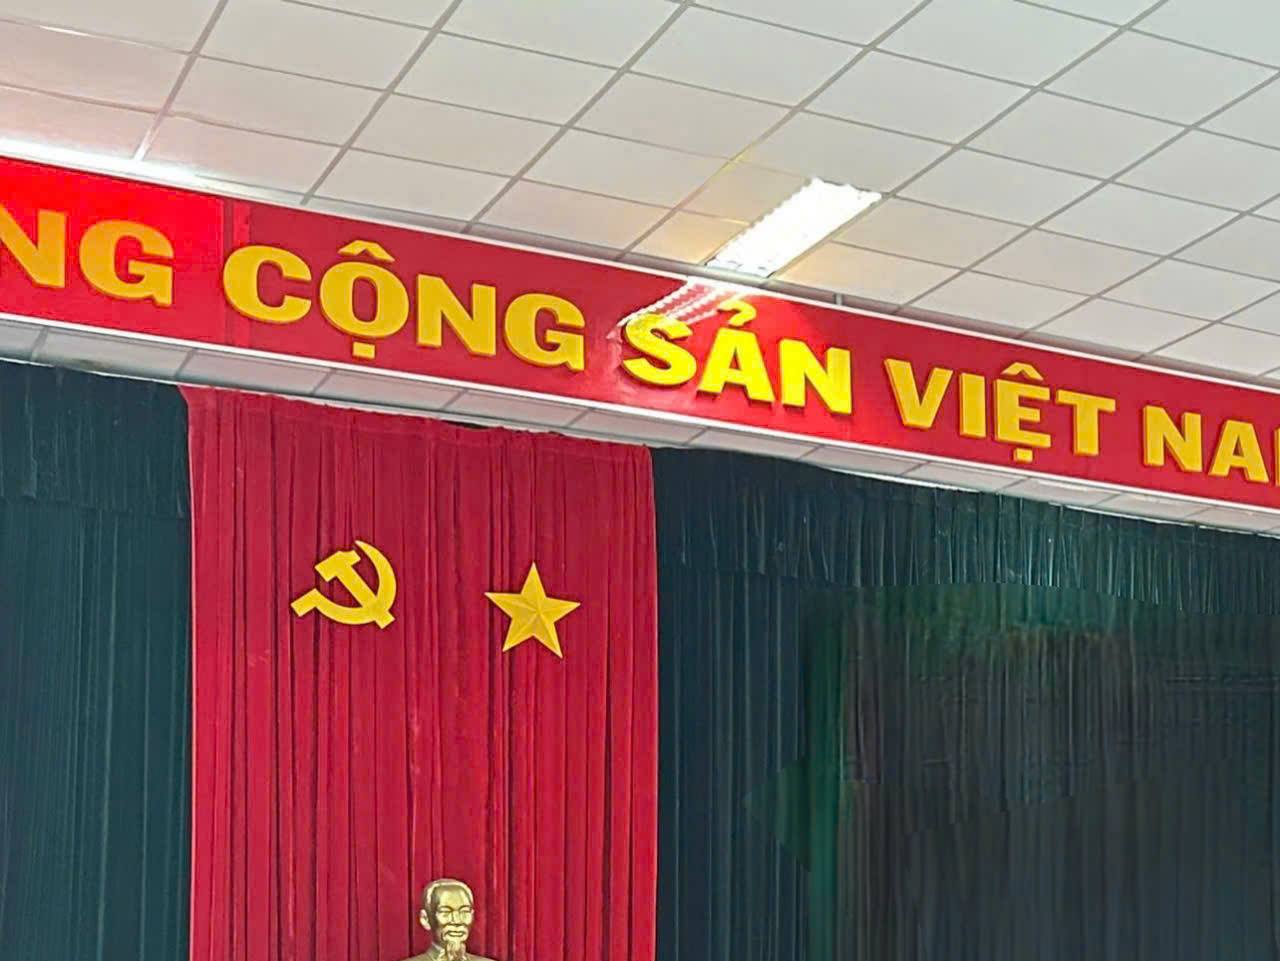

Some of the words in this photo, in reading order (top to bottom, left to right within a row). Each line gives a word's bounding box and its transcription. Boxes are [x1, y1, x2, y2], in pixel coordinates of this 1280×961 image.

[222, 238, 585, 372] CỘNG
[621, 299, 854, 415] SẢN
[884, 358, 1116, 463] VIỆT
